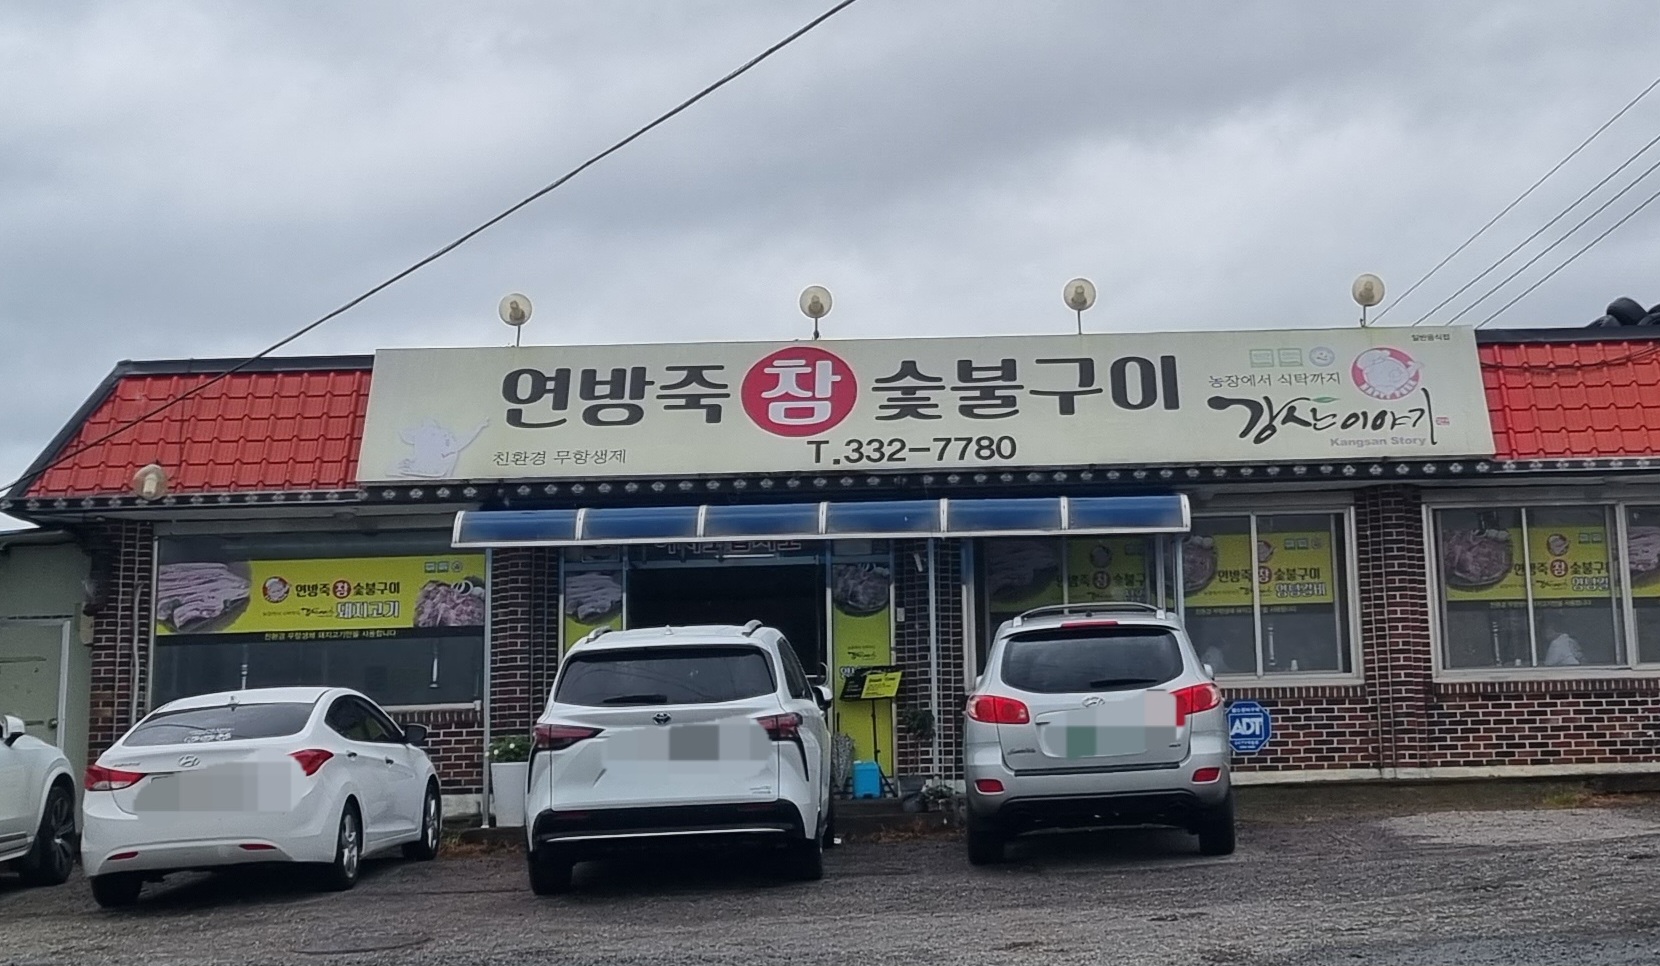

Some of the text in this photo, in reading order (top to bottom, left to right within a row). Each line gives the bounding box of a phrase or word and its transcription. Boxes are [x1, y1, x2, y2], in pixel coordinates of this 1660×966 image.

[1208, 372, 1342, 388] 농장에서 식탁까지
[501, 354, 1181, 429] 연방죽 참 숯불구이
[1207, 387, 1438, 446] 강산이야기
[806, 435, 1017, 466] T.332-7780
[1330, 436, 1427, 448] Kangsan Story
[492, 448, 627, 467] 친환경 무항생제
[335, 601, 400, 619] 돼지고기
[1230, 717, 1263, 735] ADT
